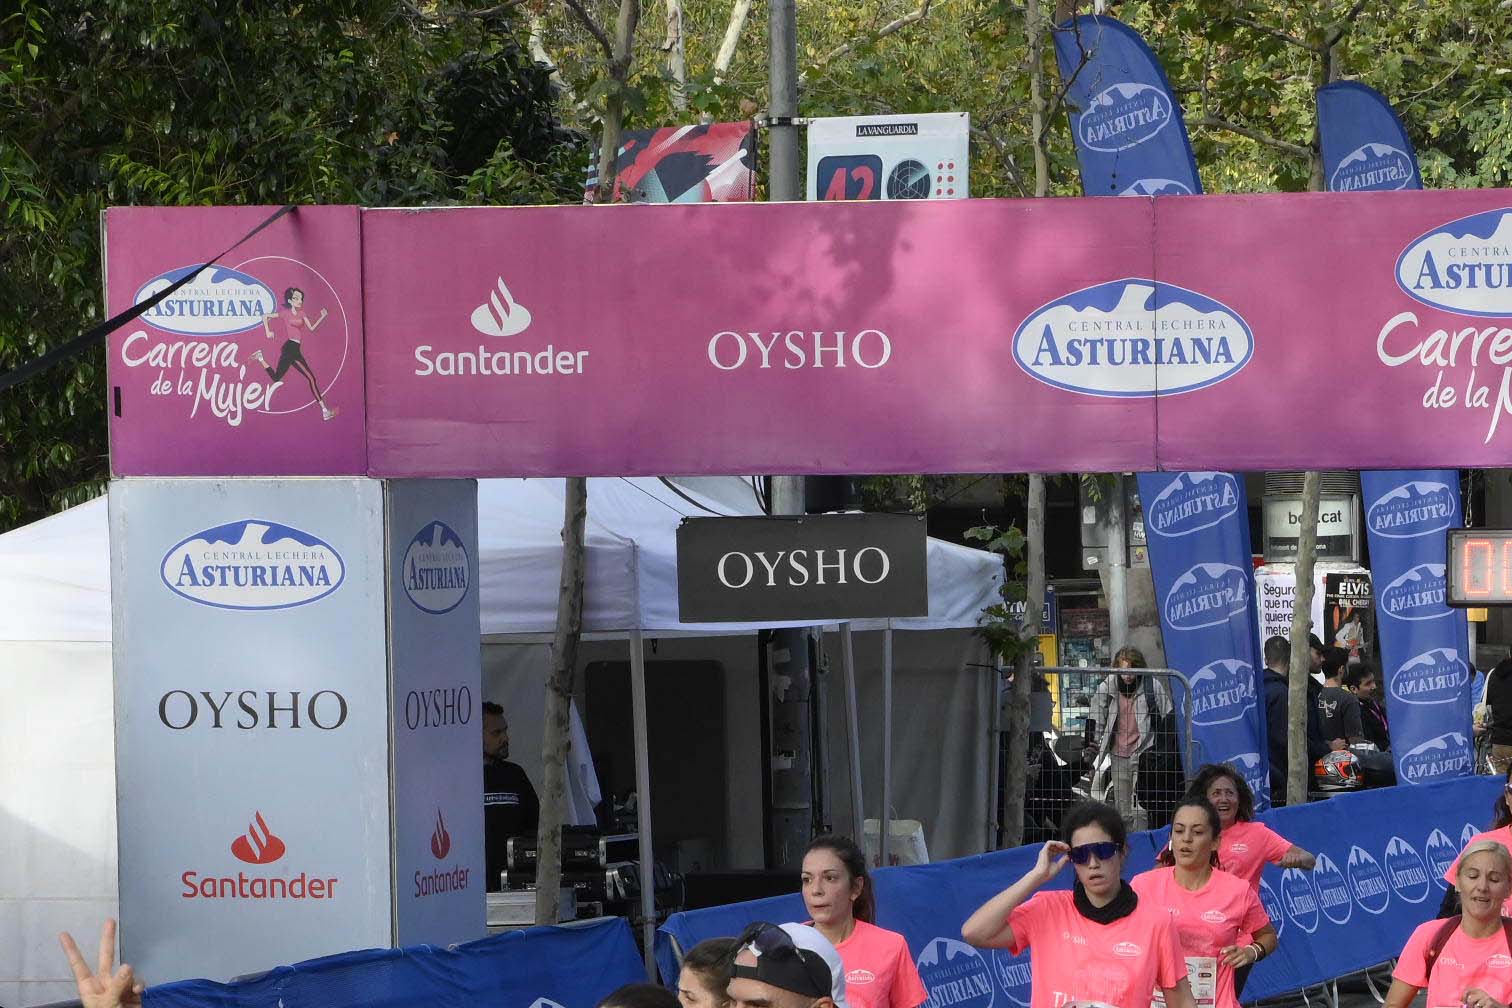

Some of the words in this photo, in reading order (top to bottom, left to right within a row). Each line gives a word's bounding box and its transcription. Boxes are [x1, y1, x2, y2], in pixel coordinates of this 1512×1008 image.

[144, 293, 265, 317] ASTURIANA
[215, 288, 261, 296] LECHERA
[1068, 319, 1146, 332] CENTRAL
[1151, 318, 1228, 331] LECHERA
[121, 331, 239, 368] Carrera
[414, 344, 589, 376] Santander
[707, 329, 892, 370] OYSHO
[1031, 322, 1235, 367] ASTURIANA
[150, 370, 173, 395] de
[177, 370, 193, 395] la
[190, 364, 284, 426] Mujer
[1422, 369, 1456, 409] de
[1465, 369, 1489, 408] la
[1289, 510, 1342, 525] bc.cat
[176, 553, 331, 588] ASTURIANA
[203, 552, 262, 560] CENTRAL
[267, 551, 325, 560] LECHERA
[717, 546, 890, 589] OYSHO
[408, 557, 466, 591] ASTURIANA
[1339, 582, 1370, 595] ELVIS
[1264, 600, 1281, 612] que
[1265, 610, 1296, 622] quiere
[158, 689, 348, 730] OYSHO
[405, 685, 471, 731] OYSHO
[182, 871, 338, 899] Santander
[414, 865, 470, 898] Santander
[1390, 863, 1426, 889] ASTURIANA
